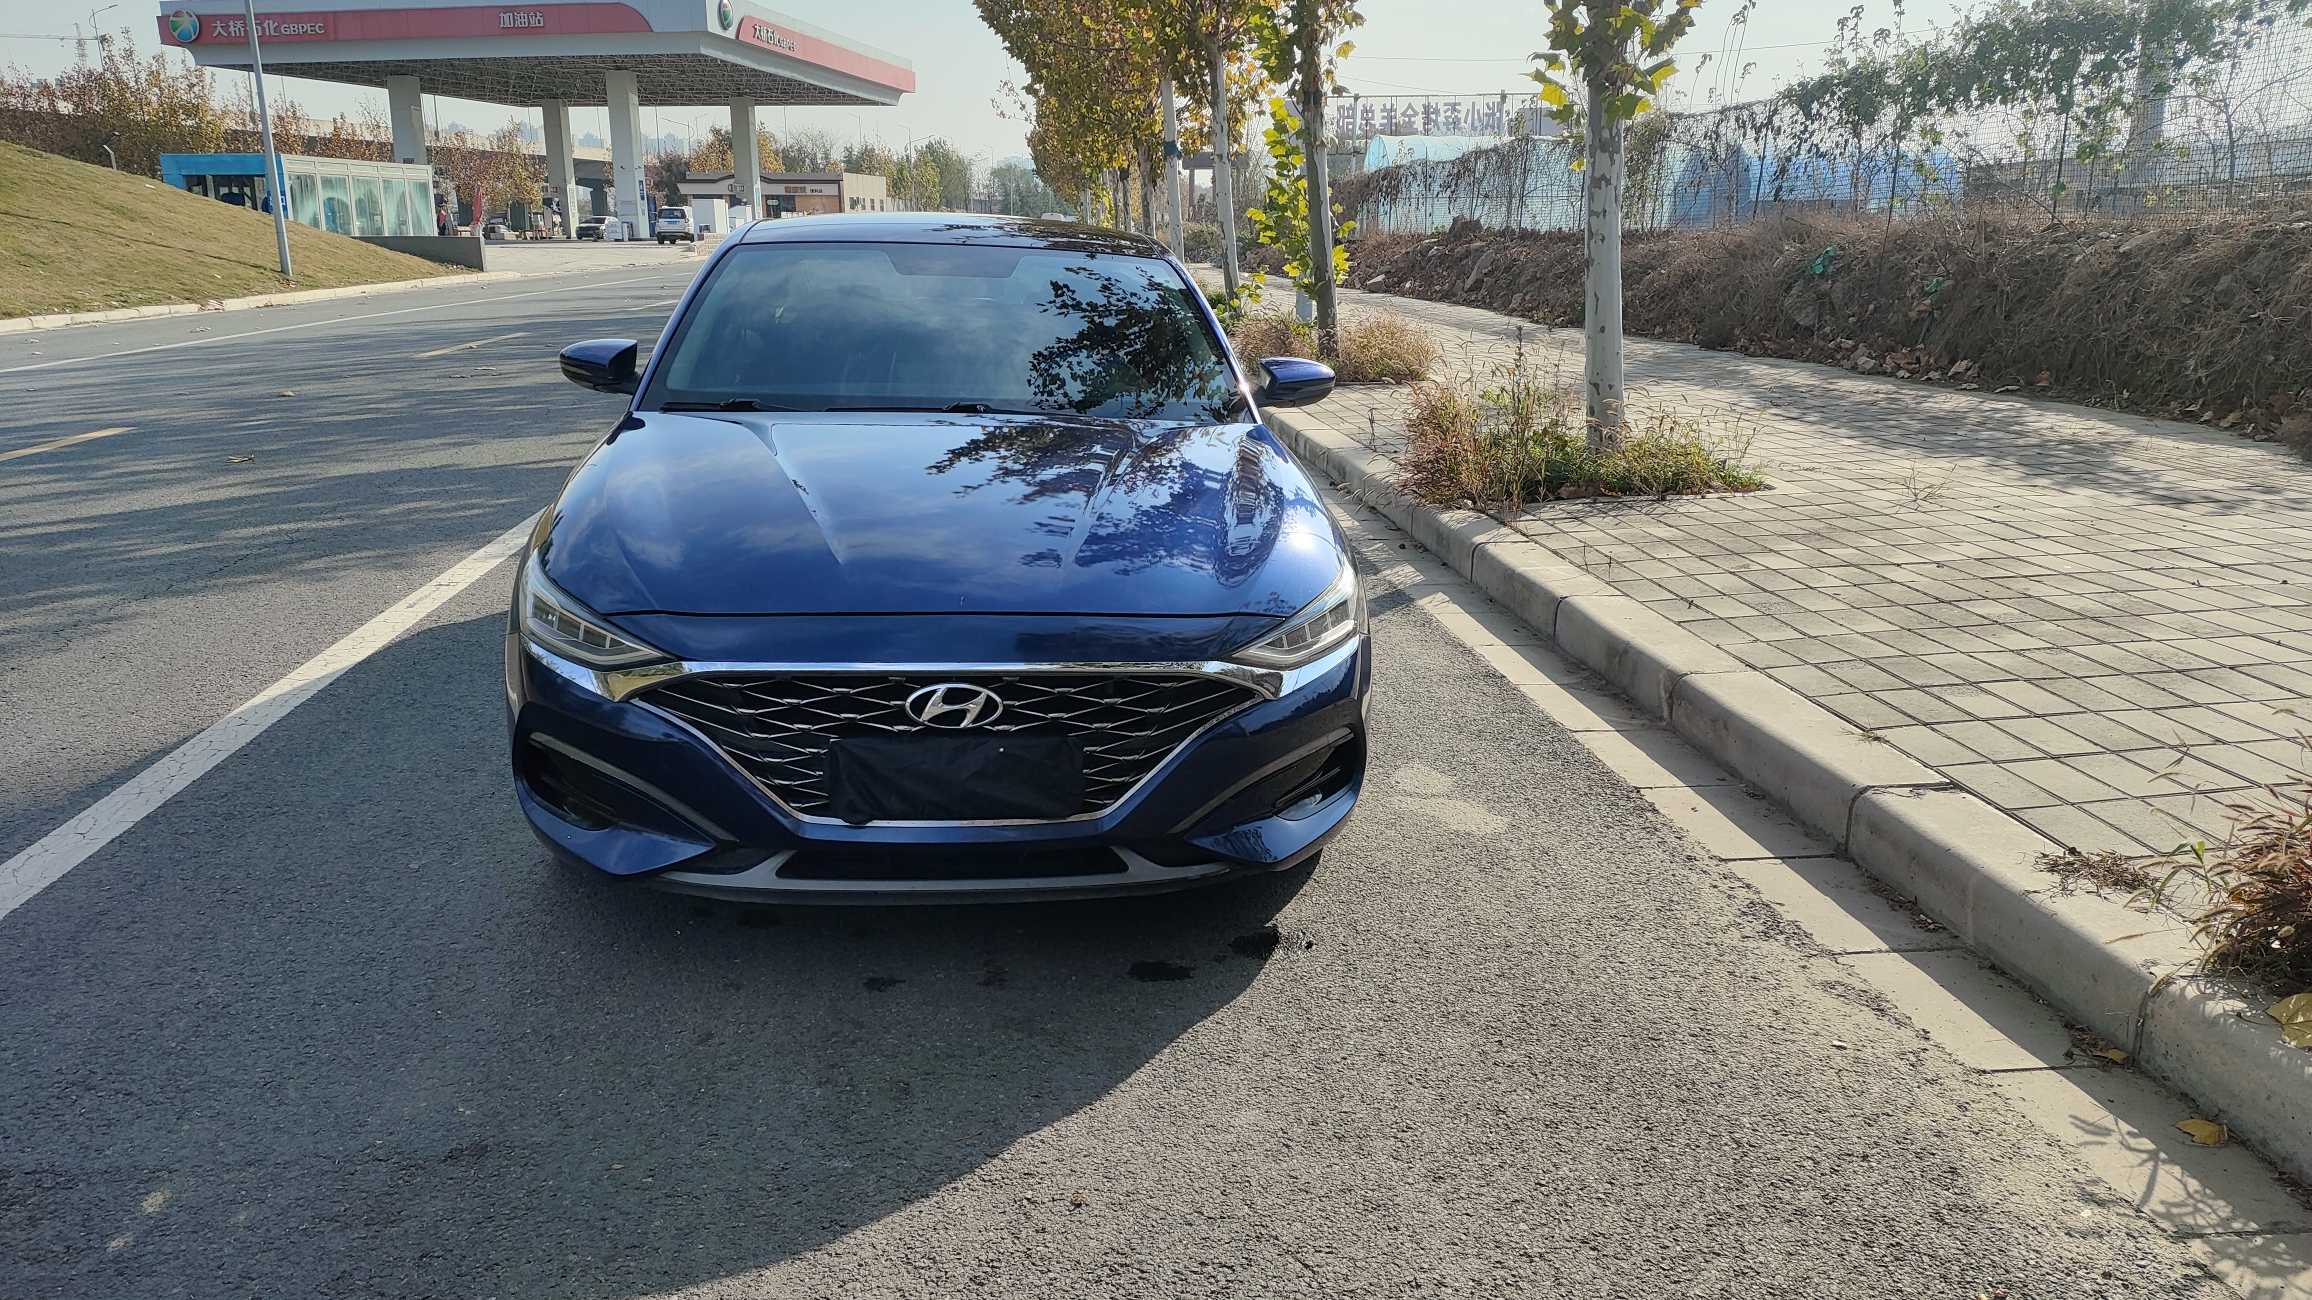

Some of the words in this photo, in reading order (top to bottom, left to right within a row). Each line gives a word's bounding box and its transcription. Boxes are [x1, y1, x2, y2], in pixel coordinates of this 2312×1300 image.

[499, 12, 544, 28] 加油站
[281, 23, 325, 35] GBPEC
